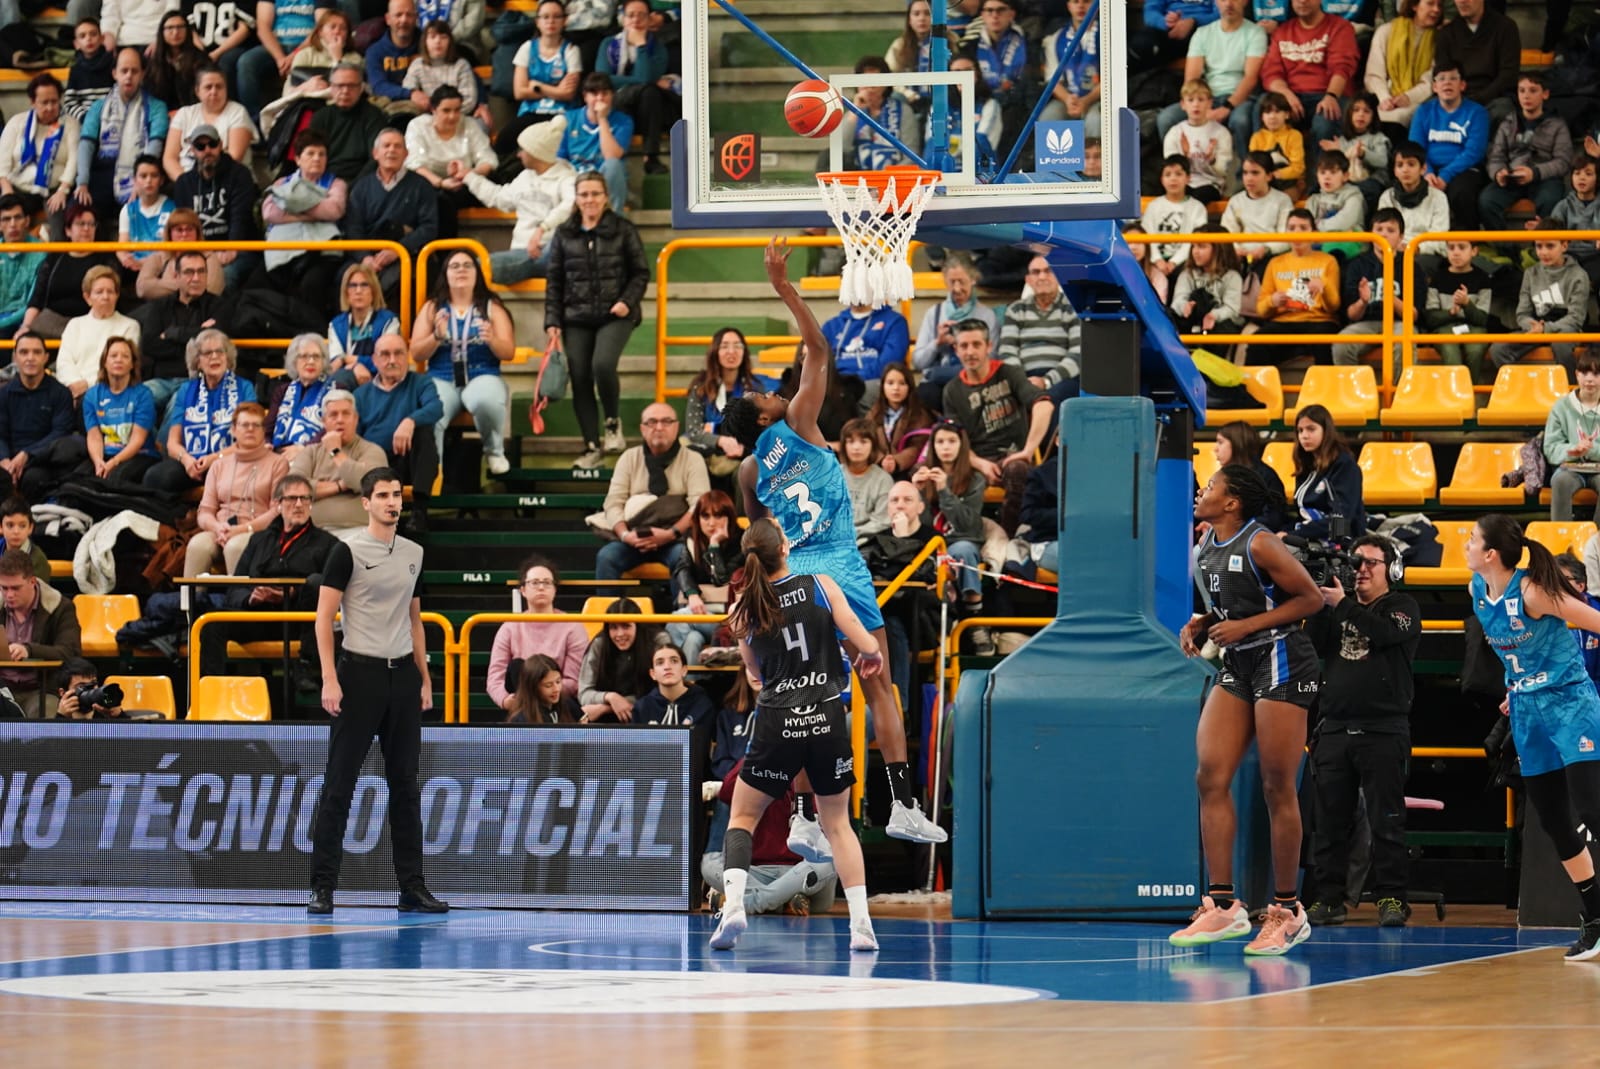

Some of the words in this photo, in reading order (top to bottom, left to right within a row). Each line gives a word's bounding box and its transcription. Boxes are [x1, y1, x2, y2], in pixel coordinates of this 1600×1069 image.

[762, 436, 789, 471] KONÉ
[572, 470, 590, 478] FILA
[593, 470, 599, 478] 5
[519, 497, 538, 505] FILA
[539, 497, 546, 505] 4
[783, 481, 823, 534] 3
[463, 573, 483, 582] FILA
[484, 573, 491, 582] 3
[1209, 573, 1221, 592] 12
[778, 587, 807, 609] IETO
[781, 622, 810, 662] 4
[775, 671, 828, 693] ékolo
[784, 713, 827, 727] HYUNDAI
[782, 729, 809, 738] Oars
[812, 725, 831, 735] Car
[751, 765, 764, 777] La
[764, 769, 789, 781] Perla
[0, 771, 73, 849] IO
[98, 752, 390, 854] TÉCNICO
[420, 776, 674, 857] OFICIAL
[1137, 884, 1195, 897] MONDO
